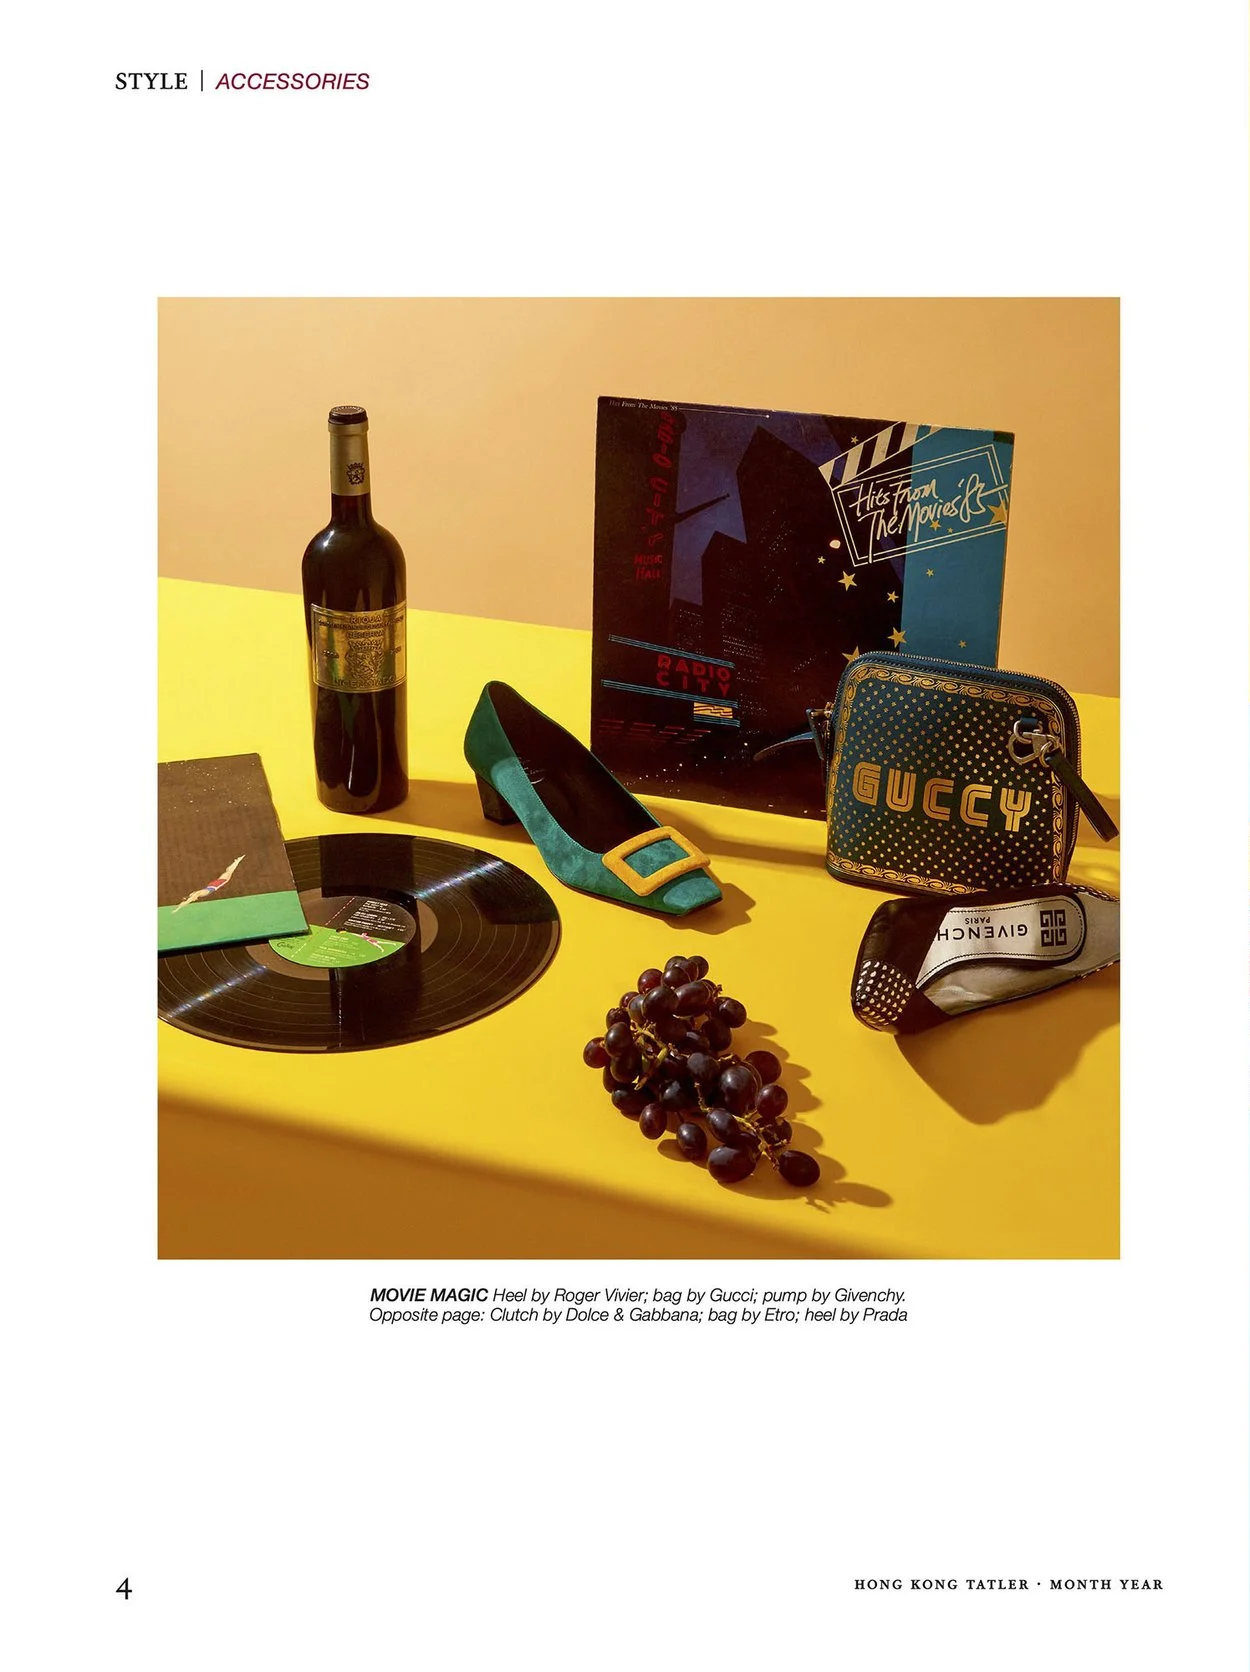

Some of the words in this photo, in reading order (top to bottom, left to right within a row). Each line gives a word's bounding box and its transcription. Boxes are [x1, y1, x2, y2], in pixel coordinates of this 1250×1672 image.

[115, 72, 188, 91] STYLE
[215, 72, 370, 91] ACCESSORIES
[649, 403, 668, 411] Movies
[849, 481, 891, 517] Hits
[889, 479, 939, 516] From
[858, 508, 900, 563] The
[898, 495, 962, 542] Movies
[657, 655, 732, 682] RADIO
[656, 670, 731, 697] CITY
[853, 761, 1032, 833] GUCCY
[965, 916, 991, 925] PARIS
[370, 1287, 427, 1302] MOVIE
[430, 1287, 488, 1302] MAGIC
[493, 1287, 527, 1302] Heel
[531, 1287, 550, 1305] by
[554, 1287, 601, 1305] Roger
[605, 1287, 648, 1304] Vivier;
[653, 1287, 682, 1305] bag
[687, 1287, 706, 1305] by
[710, 1287, 758, 1304] Gucci;
[762, 1291, 807, 1305] pump
[812, 1287, 831, 1305] by
[835, 1287, 906, 1305] Givenchy.
[369, 1307, 438, 1324] Opposite
[440, 1311, 485, 1325] page:
[491, 1307, 538, 1321] Clutch
[543, 1307, 562, 1325] by
[566, 1307, 609, 1321] Dolce
[613, 1307, 625, 1322] &
[629, 1307, 703, 1323] Gabbana;
[708, 1307, 737, 1325] bag
[742, 1307, 761, 1325] by
[765, 1307, 800, 1323] Etro;
[804, 1307, 836, 1321] heel
[840, 1307, 859, 1325] by
[863, 1307, 908, 1321] Prada
[115, 1576, 133, 1601] 4
[854, 1578, 903, 1591] HONG
[910, 1578, 959, 1591] KONG
[966, 1578, 1029, 1591] TATLER
[1050, 1578, 1112, 1591] MONTH
[1119, 1578, 1164, 1591] YEAR
